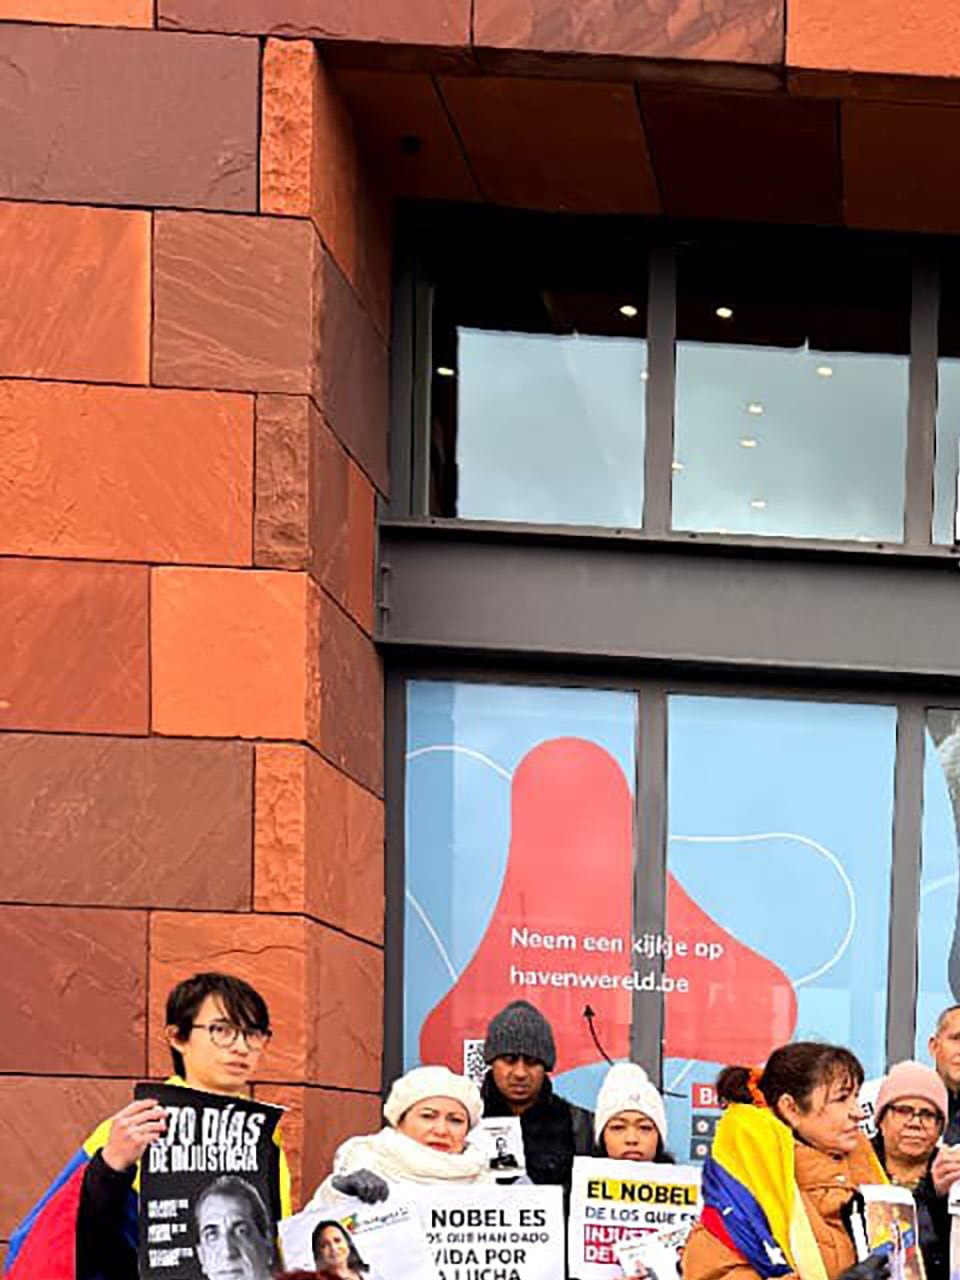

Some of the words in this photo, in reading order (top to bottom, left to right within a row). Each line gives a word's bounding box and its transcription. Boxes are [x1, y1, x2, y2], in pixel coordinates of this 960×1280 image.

[511, 928, 576, 949] Neem
[583, 935, 622, 952] een
[632, 934, 688, 958] kijkje
[695, 942, 723, 960] op
[510, 965, 689, 992] havenwereld.be
[162, 1106, 196, 1146] 70
[202, 1104, 266, 1146] DÍAS
[149, 1146, 168, 1173] DE
[171, 1144, 259, 1172] INJUSTICIA
[587, 1181, 613, 1199] EL
[621, 1182, 697, 1205] NOBEL
[431, 1209, 512, 1228] NOBEL
[519, 1209, 546, 1227] ES
[585, 1206, 606, 1220] DE
[610, 1208, 639, 1221] LOS
[644, 1211, 676, 1224] QUE
[447, 1232, 474, 1243] QUE
[478, 1232, 506, 1243] HAN
[485, 1248, 526, 1264] POR
